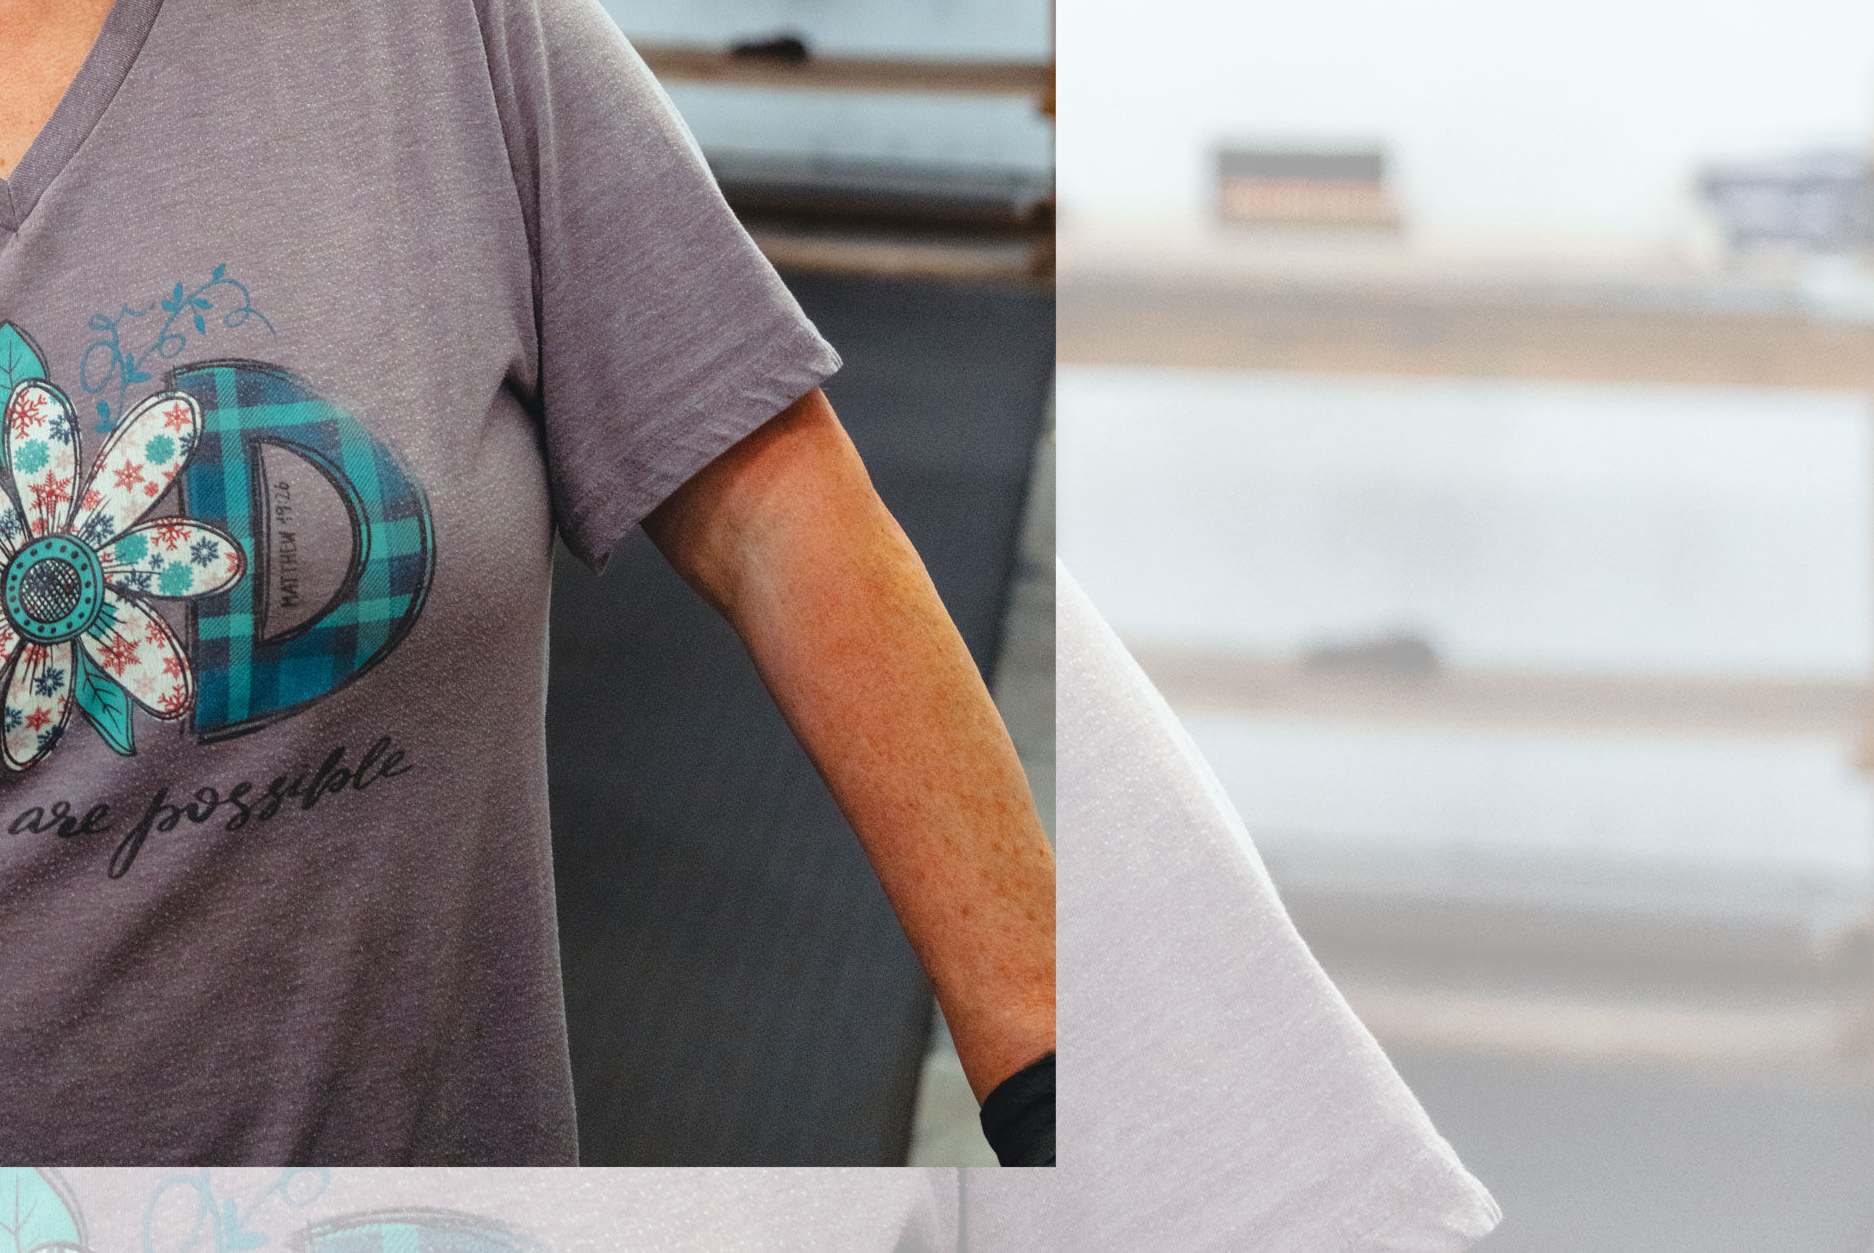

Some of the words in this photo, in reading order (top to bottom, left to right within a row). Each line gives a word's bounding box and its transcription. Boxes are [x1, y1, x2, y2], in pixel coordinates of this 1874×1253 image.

[273, 480, 293, 525] 19:26
[278, 531, 298, 609] MATTHEW
[8, 800, 112, 838] are
[107, 736, 413, 880] possible
